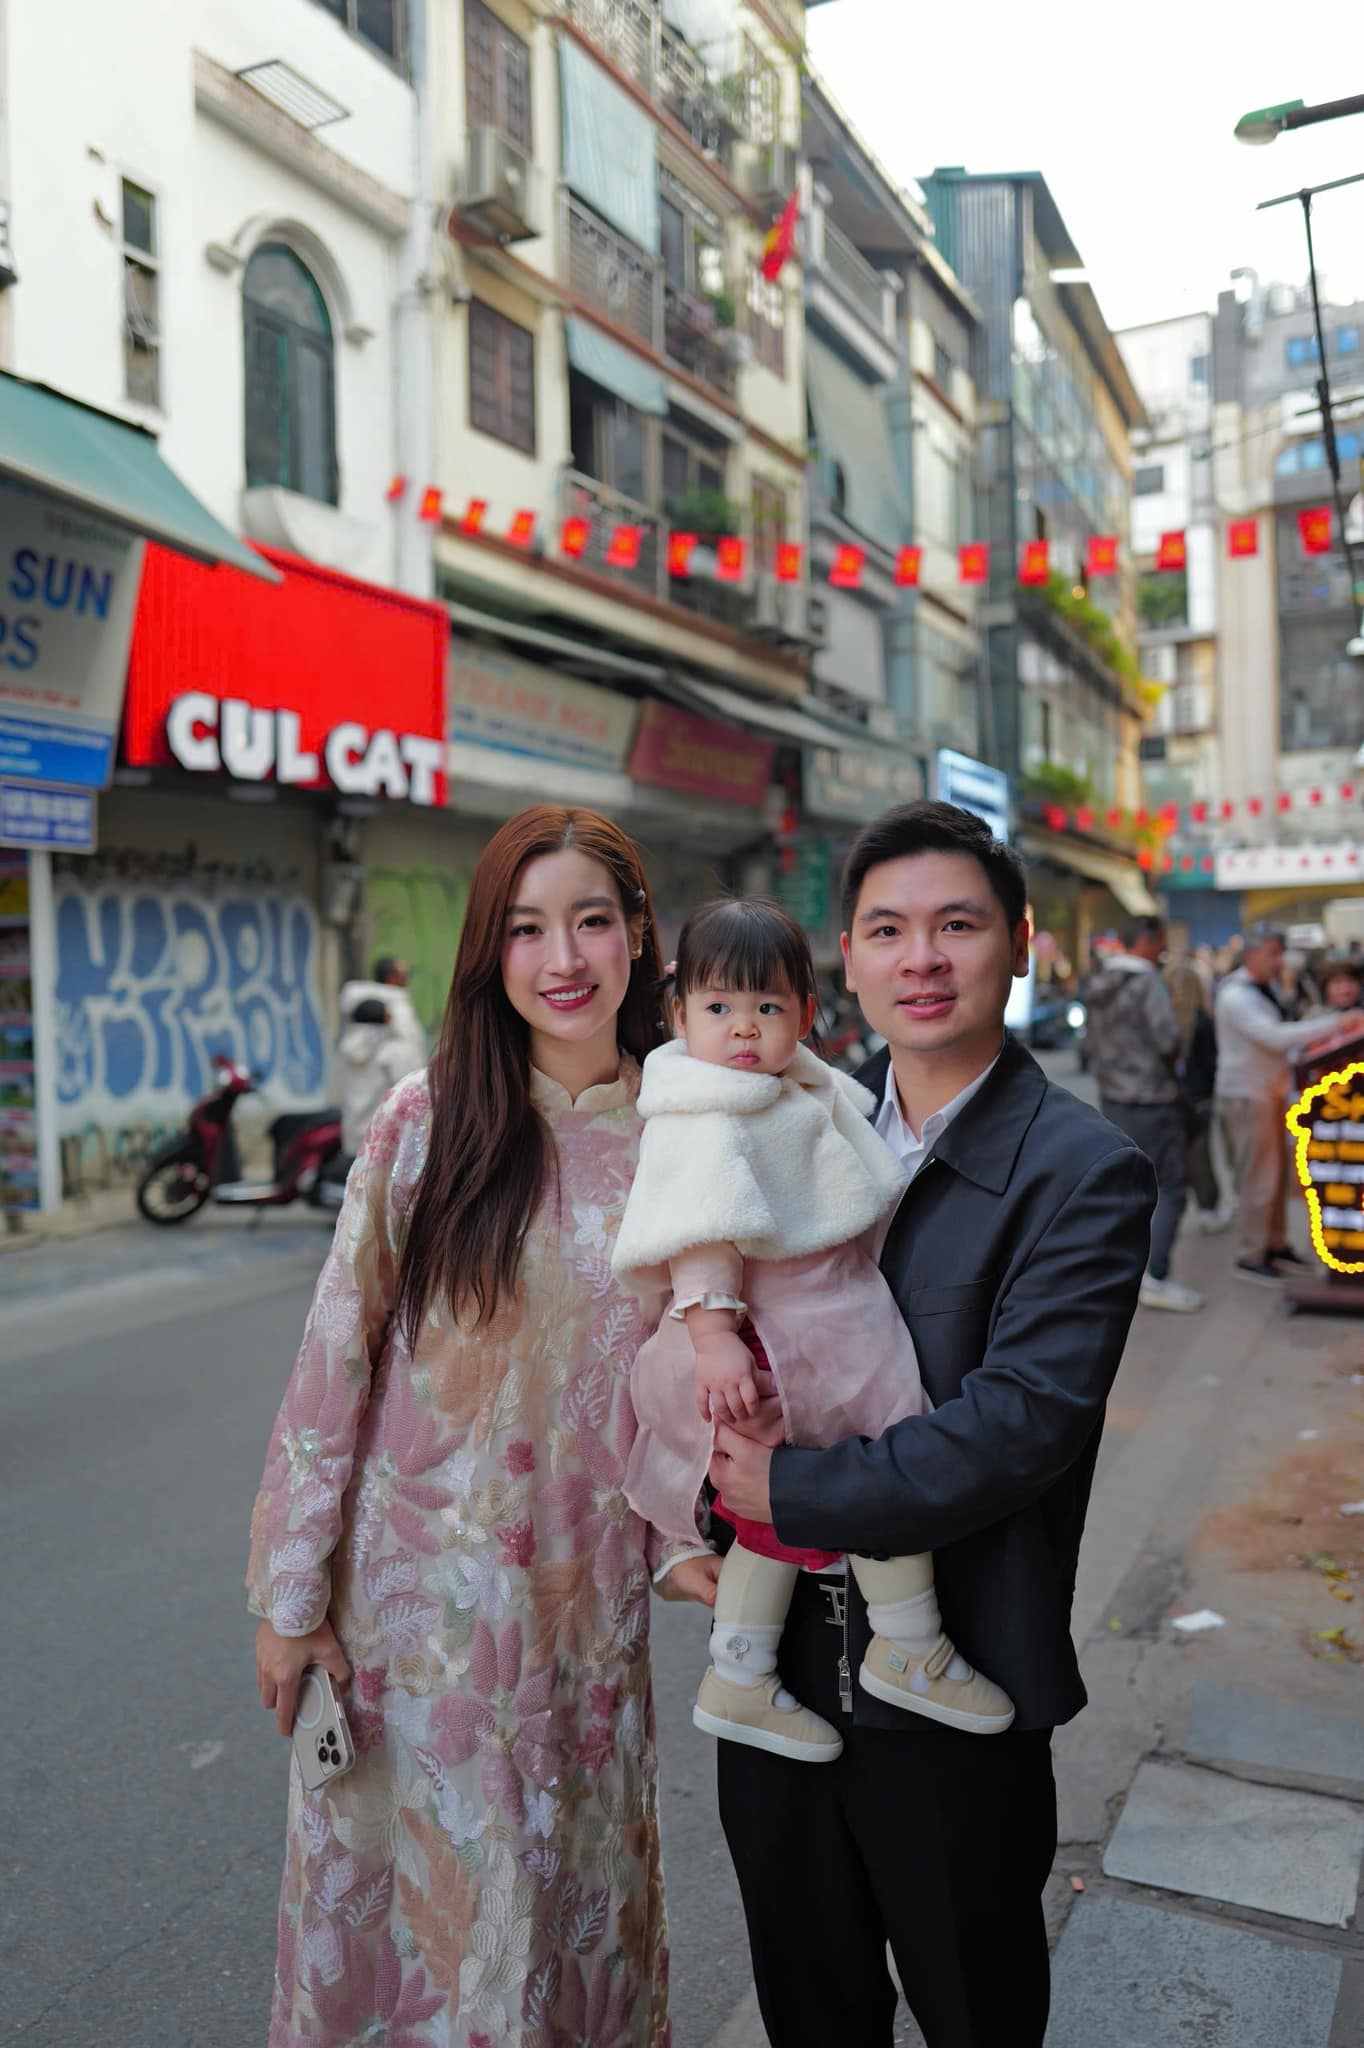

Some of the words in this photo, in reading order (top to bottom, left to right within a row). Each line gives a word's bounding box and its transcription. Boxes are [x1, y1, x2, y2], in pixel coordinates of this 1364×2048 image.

[10, 546, 113, 621] SUN
[166, 690, 319, 784] CUL
[324, 721, 443, 806] CAT
